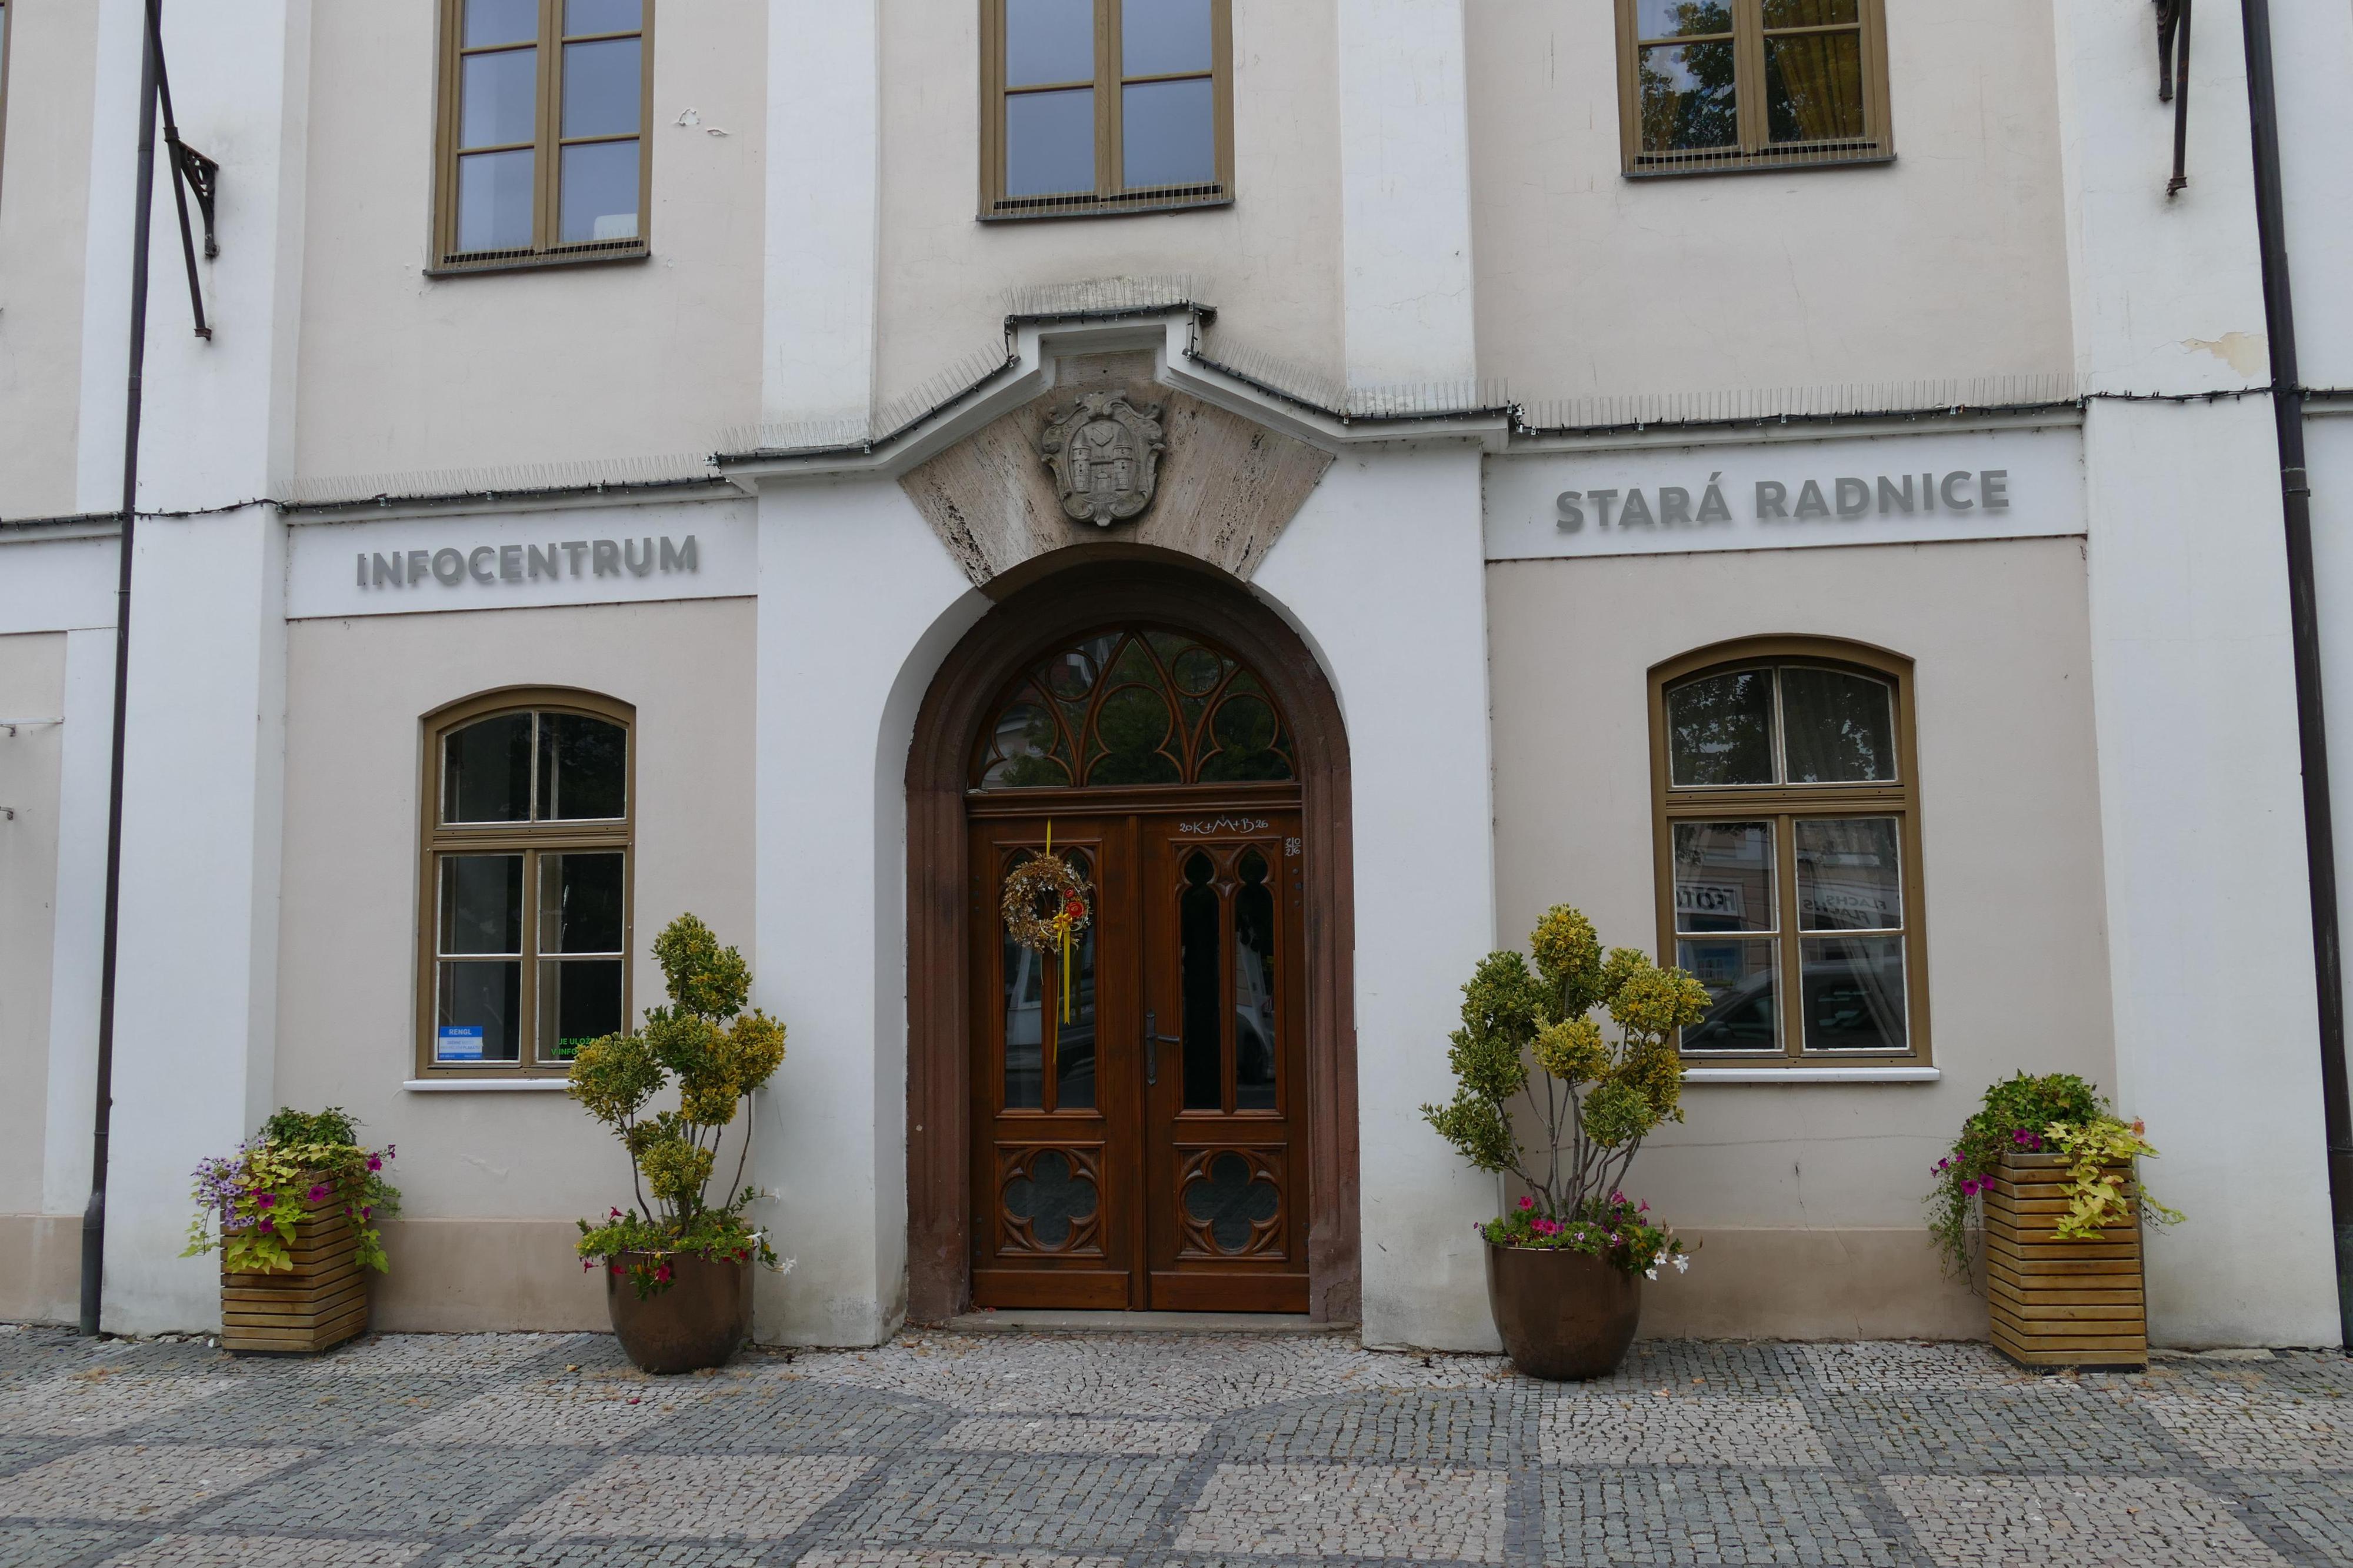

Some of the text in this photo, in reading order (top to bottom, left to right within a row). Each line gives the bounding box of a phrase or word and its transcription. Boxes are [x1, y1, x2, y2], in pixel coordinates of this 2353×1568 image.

[1556, 469, 2009, 529] STARÁ RADNICE
[356, 535, 696, 586] INFOCENTRUM
